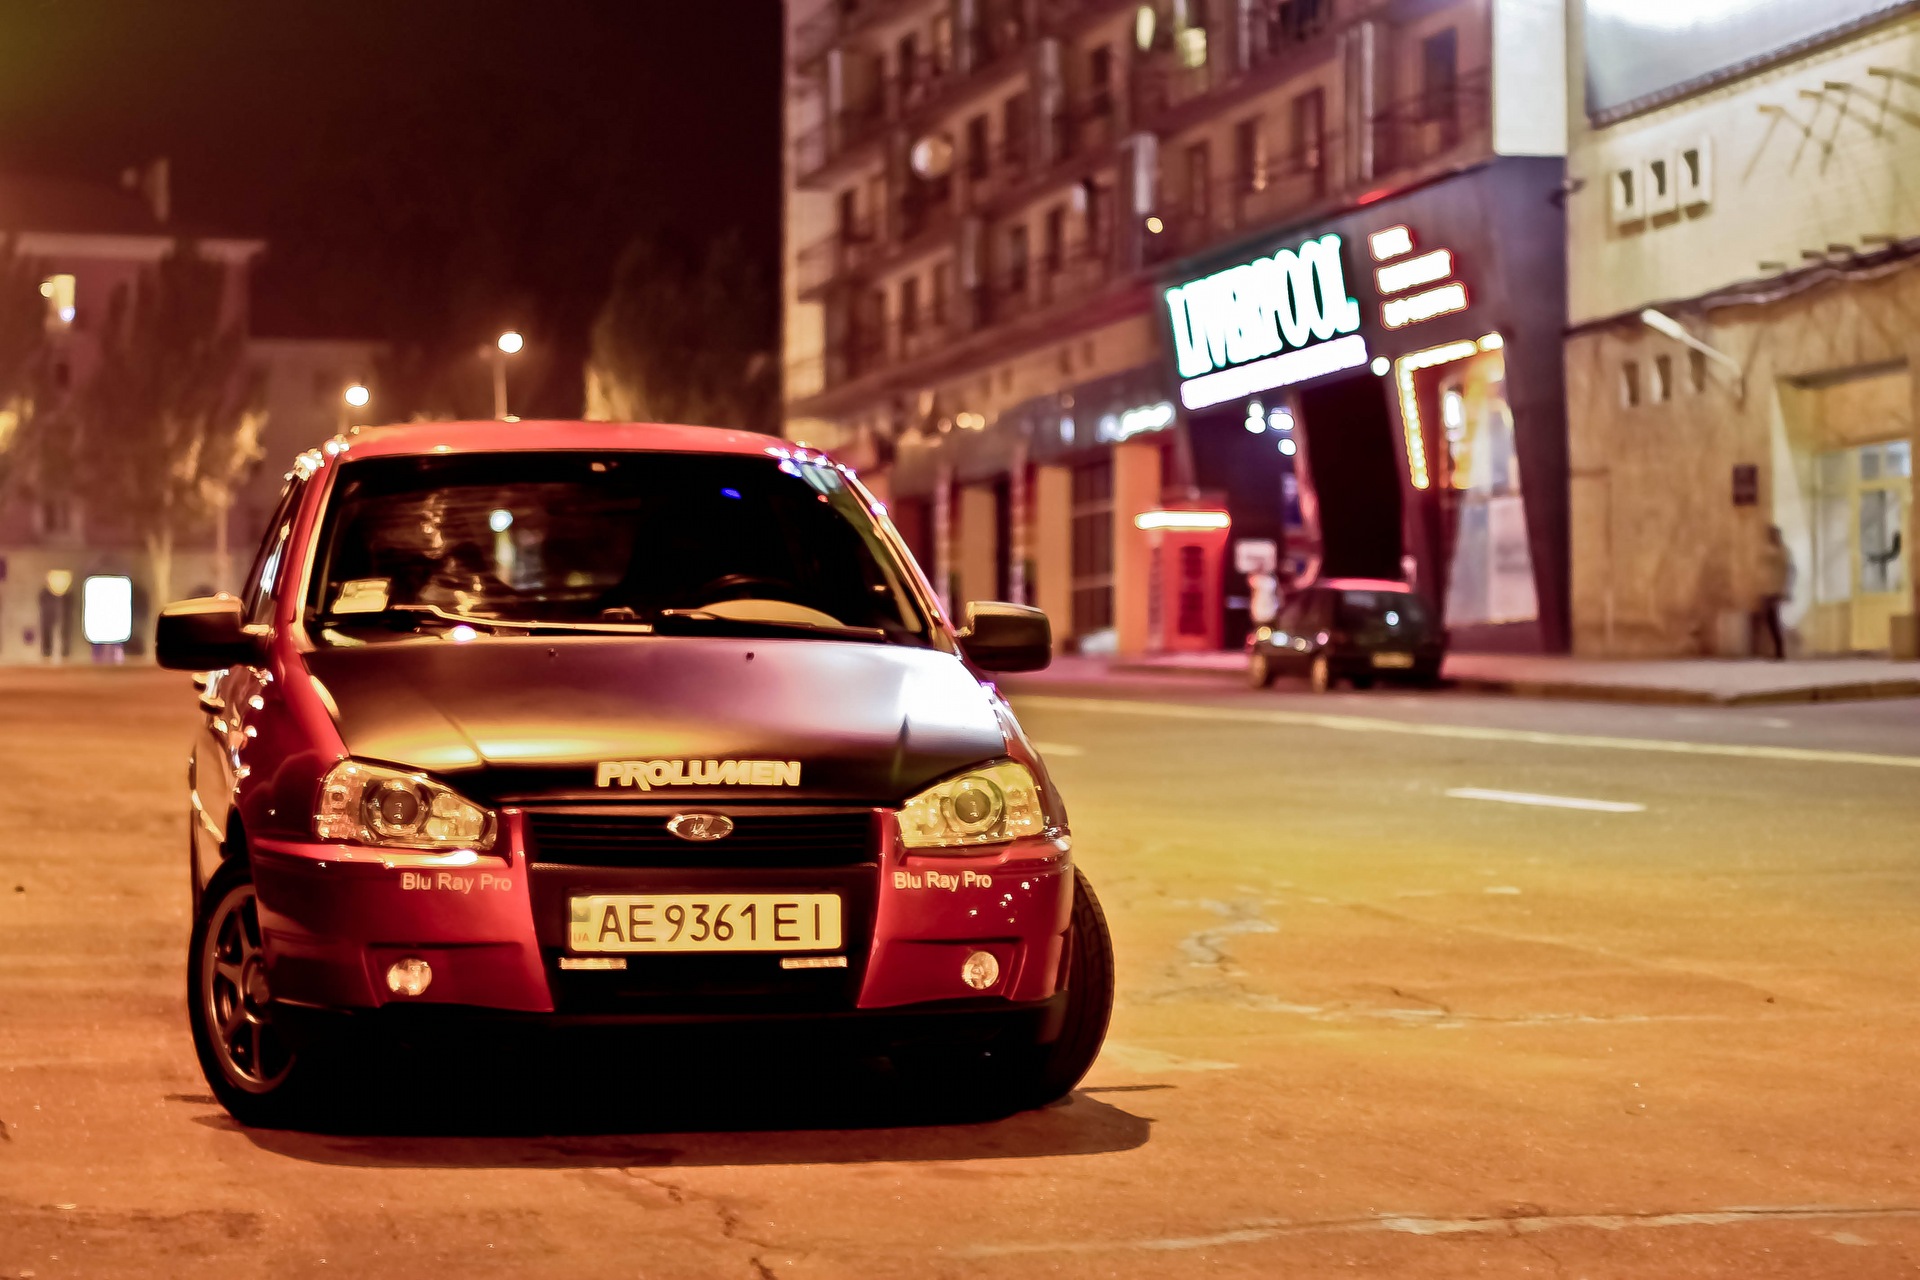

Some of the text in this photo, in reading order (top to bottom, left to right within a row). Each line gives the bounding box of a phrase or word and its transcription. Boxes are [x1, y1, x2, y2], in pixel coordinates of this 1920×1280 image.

[597, 760, 801, 791] PROLUMEN
[402, 872, 512, 894] Blu Ray Pro
[894, 870, 992, 892] Blu Ray Pro
